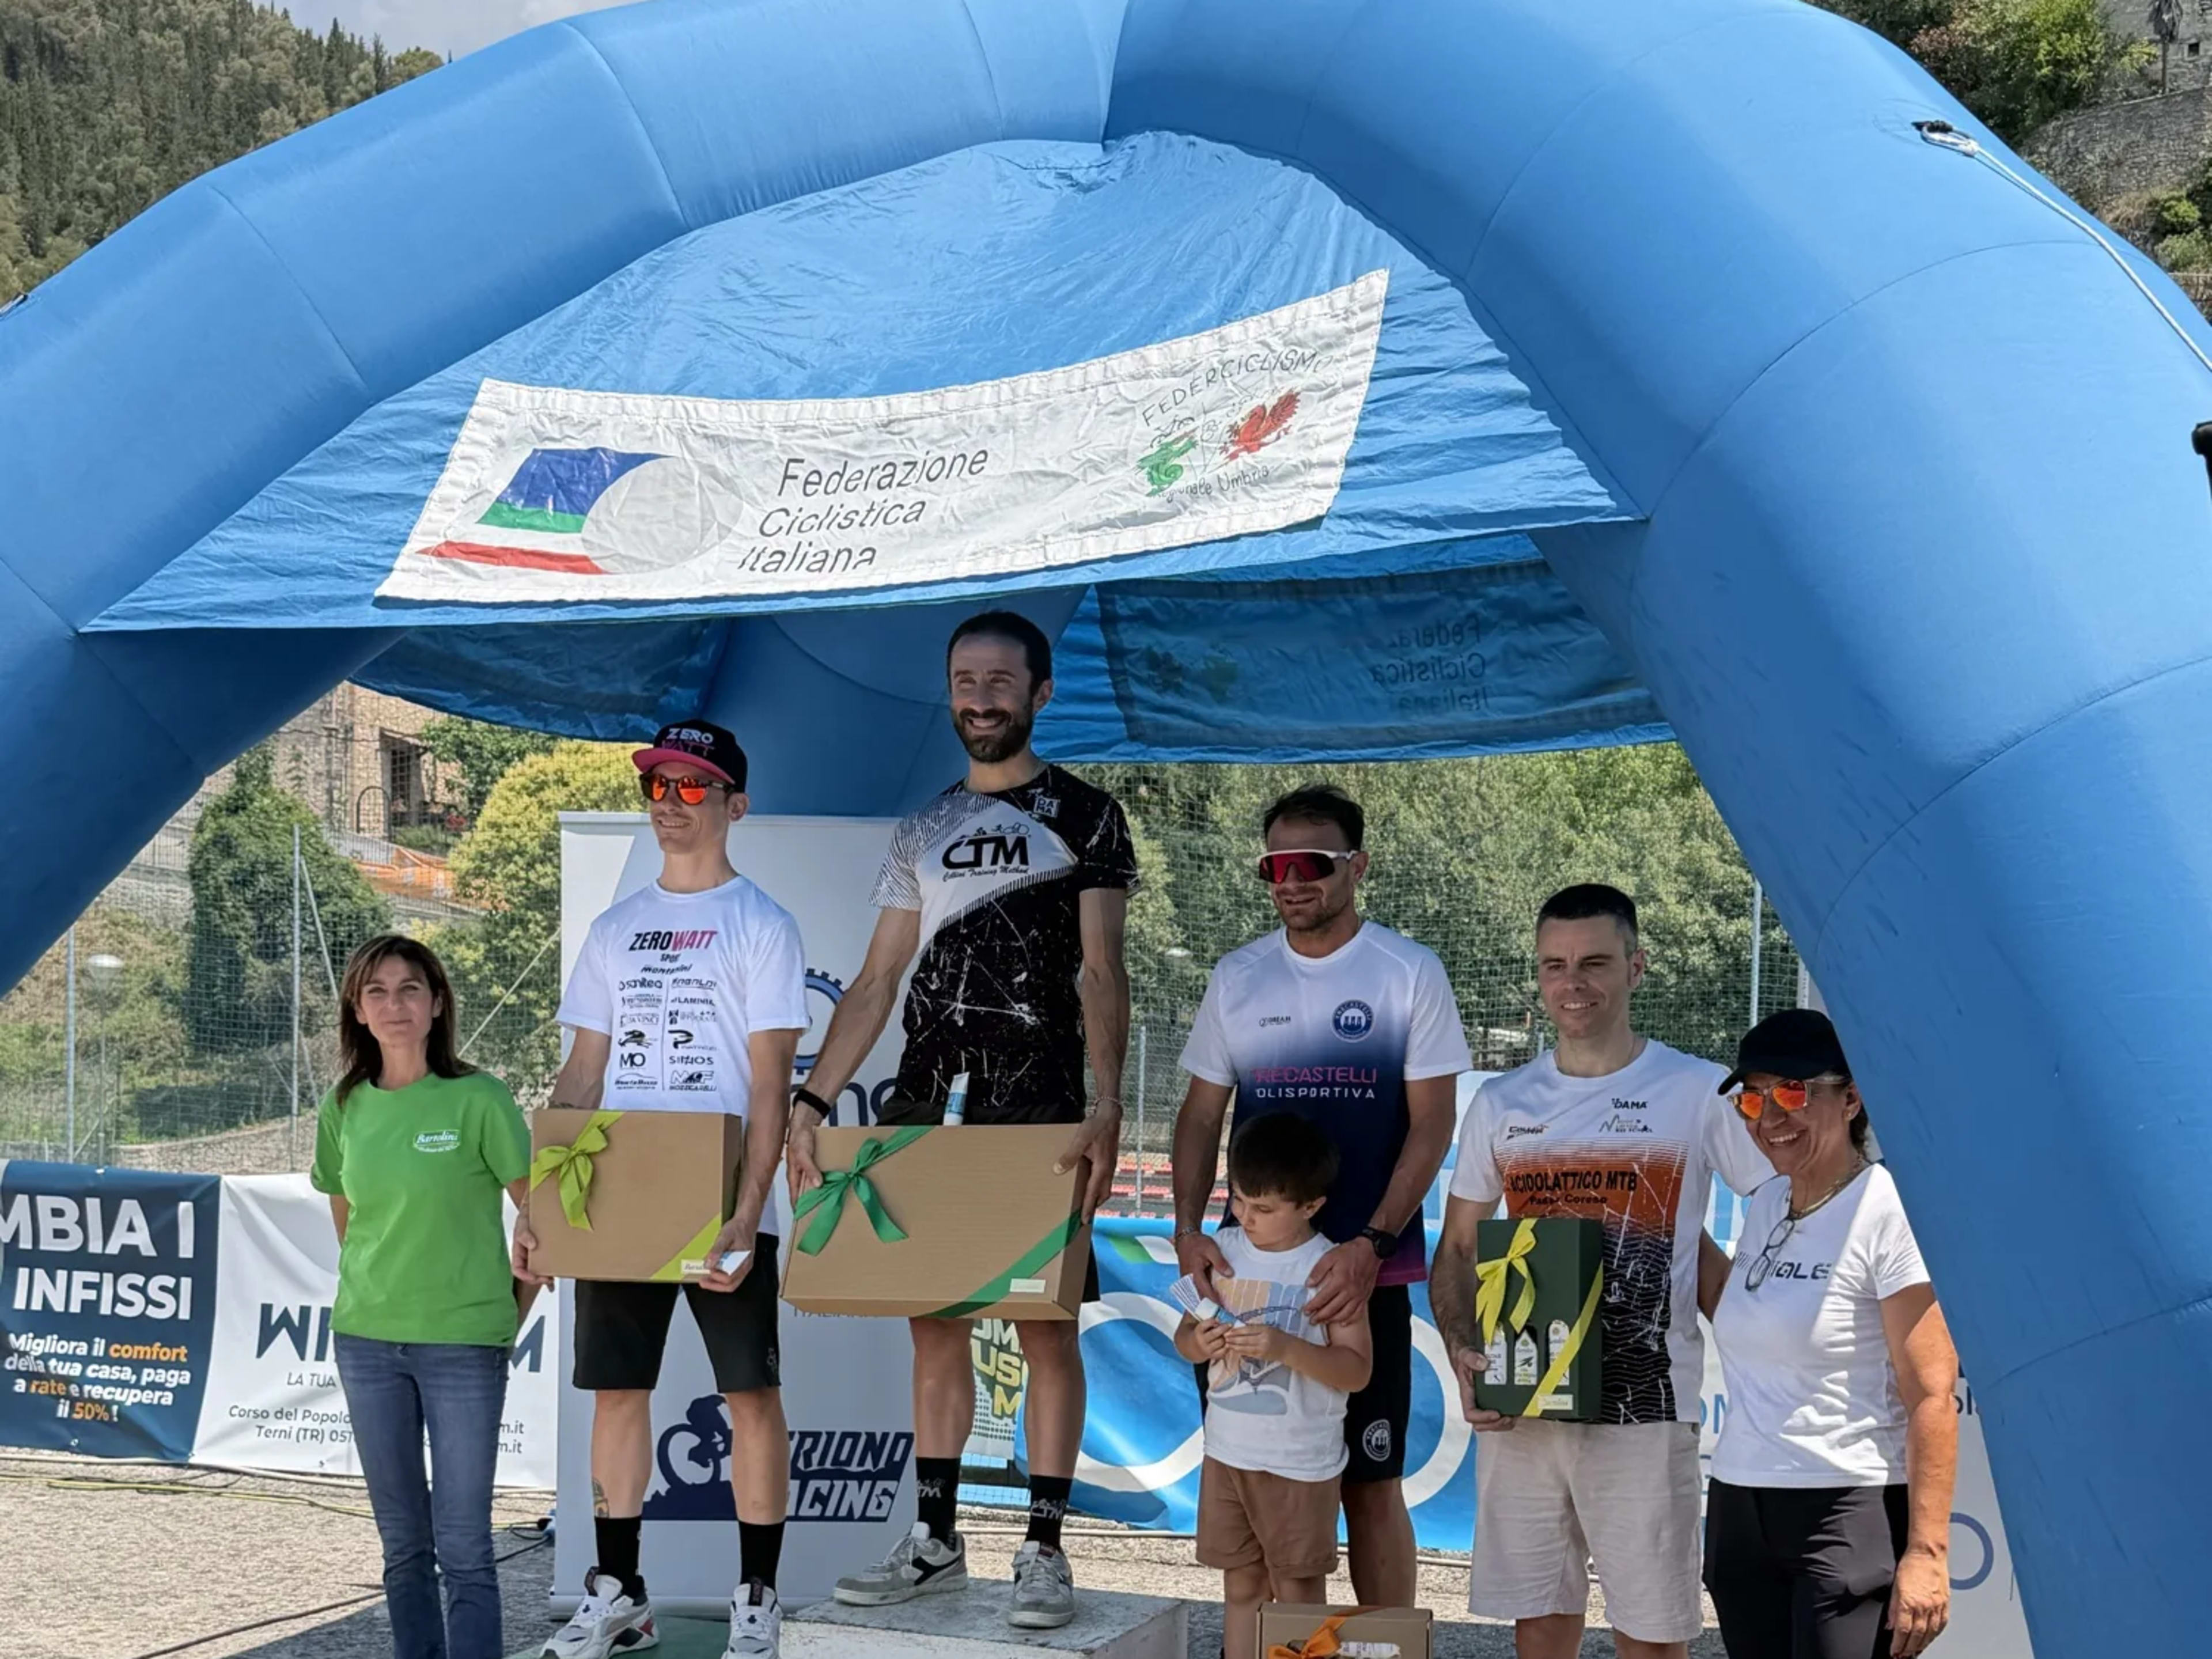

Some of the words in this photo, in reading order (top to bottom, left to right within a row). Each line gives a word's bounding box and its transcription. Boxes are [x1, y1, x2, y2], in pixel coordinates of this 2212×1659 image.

[778, 449, 988, 497] Federazione
[1217, 465, 1270, 491] Umbria
[759, 498, 927, 537] Ciclistica
[737, 540, 877, 573] Italiana
[666, 728, 714, 744] ZERO
[942, 835, 1030, 869] CTM
[628, 930, 718, 951] ZEROWATT
[1256, 1087, 1376, 1099] OLISPORTIVA
[1605, 1171, 1638, 1191] MTB
[178, 1201, 195, 1258] I
[13, 1267, 192, 1320] INFISSI
[9, 1332, 88, 1356] Migliora
[92, 1338, 106, 1357] il
[109, 1342, 188, 1362] comfort
[4, 1353, 46, 1373] della
[48, 1358, 83, 1376] tua
[86, 1363, 137, 1384] casa,
[141, 1367, 191, 1388] paga
[286, 1372, 304, 1386] LA
[309, 1372, 337, 1388] TUA
[13, 1377, 26, 1393] a
[29, 1380, 66, 1395] rate
[69, 1384, 79, 1396] e
[83, 1383, 173, 1406] recupera
[56, 1398, 70, 1418] il
[72, 1402, 109, 1421] 50%
[229, 1404, 270, 1420] Corso
[274, 1407, 297, 1421] del
[301, 1409, 352, 1425] Popolo
[255, 1425, 293, 1440] Terni
[296, 1427, 325, 1444] (TR)
[789, 1431, 915, 1469] RIONO
